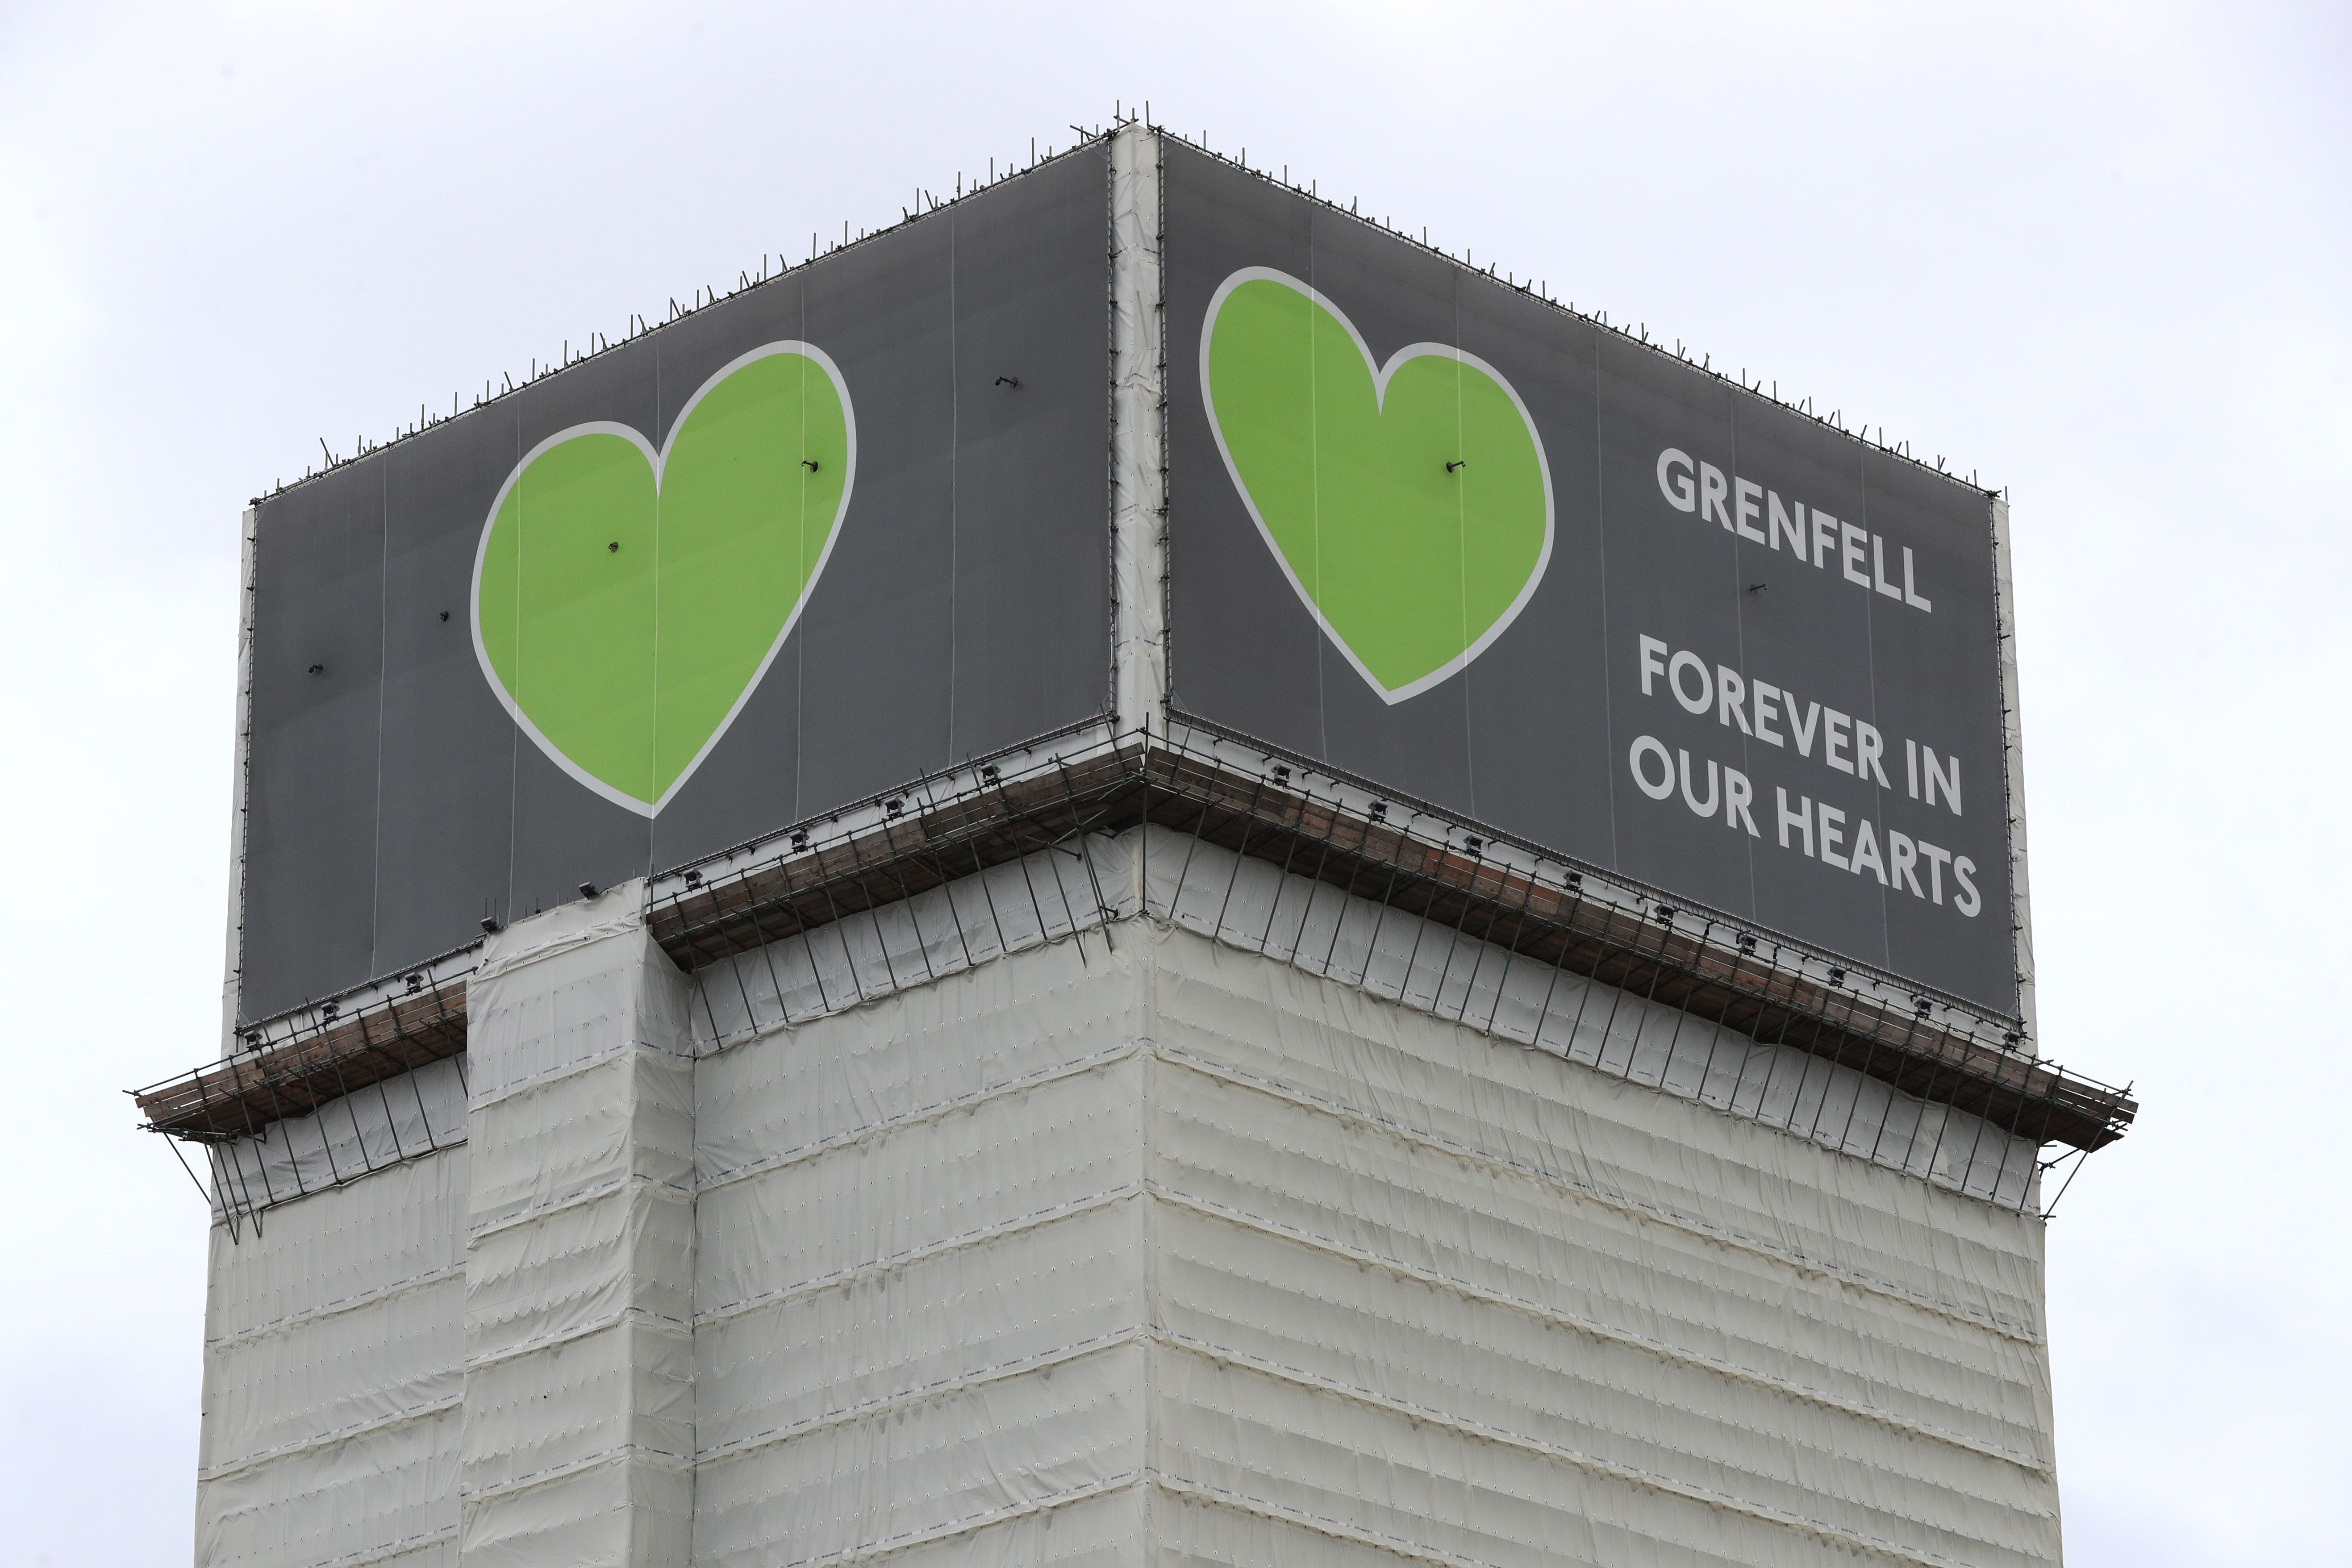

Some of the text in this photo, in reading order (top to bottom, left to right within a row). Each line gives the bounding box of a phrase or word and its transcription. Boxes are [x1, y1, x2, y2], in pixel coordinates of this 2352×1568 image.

[1657, 448, 1931, 613] GRENFELL
[1639, 633, 1962, 816] FOREVER IN
[1630, 735, 1981, 917] OUR HEARTS
